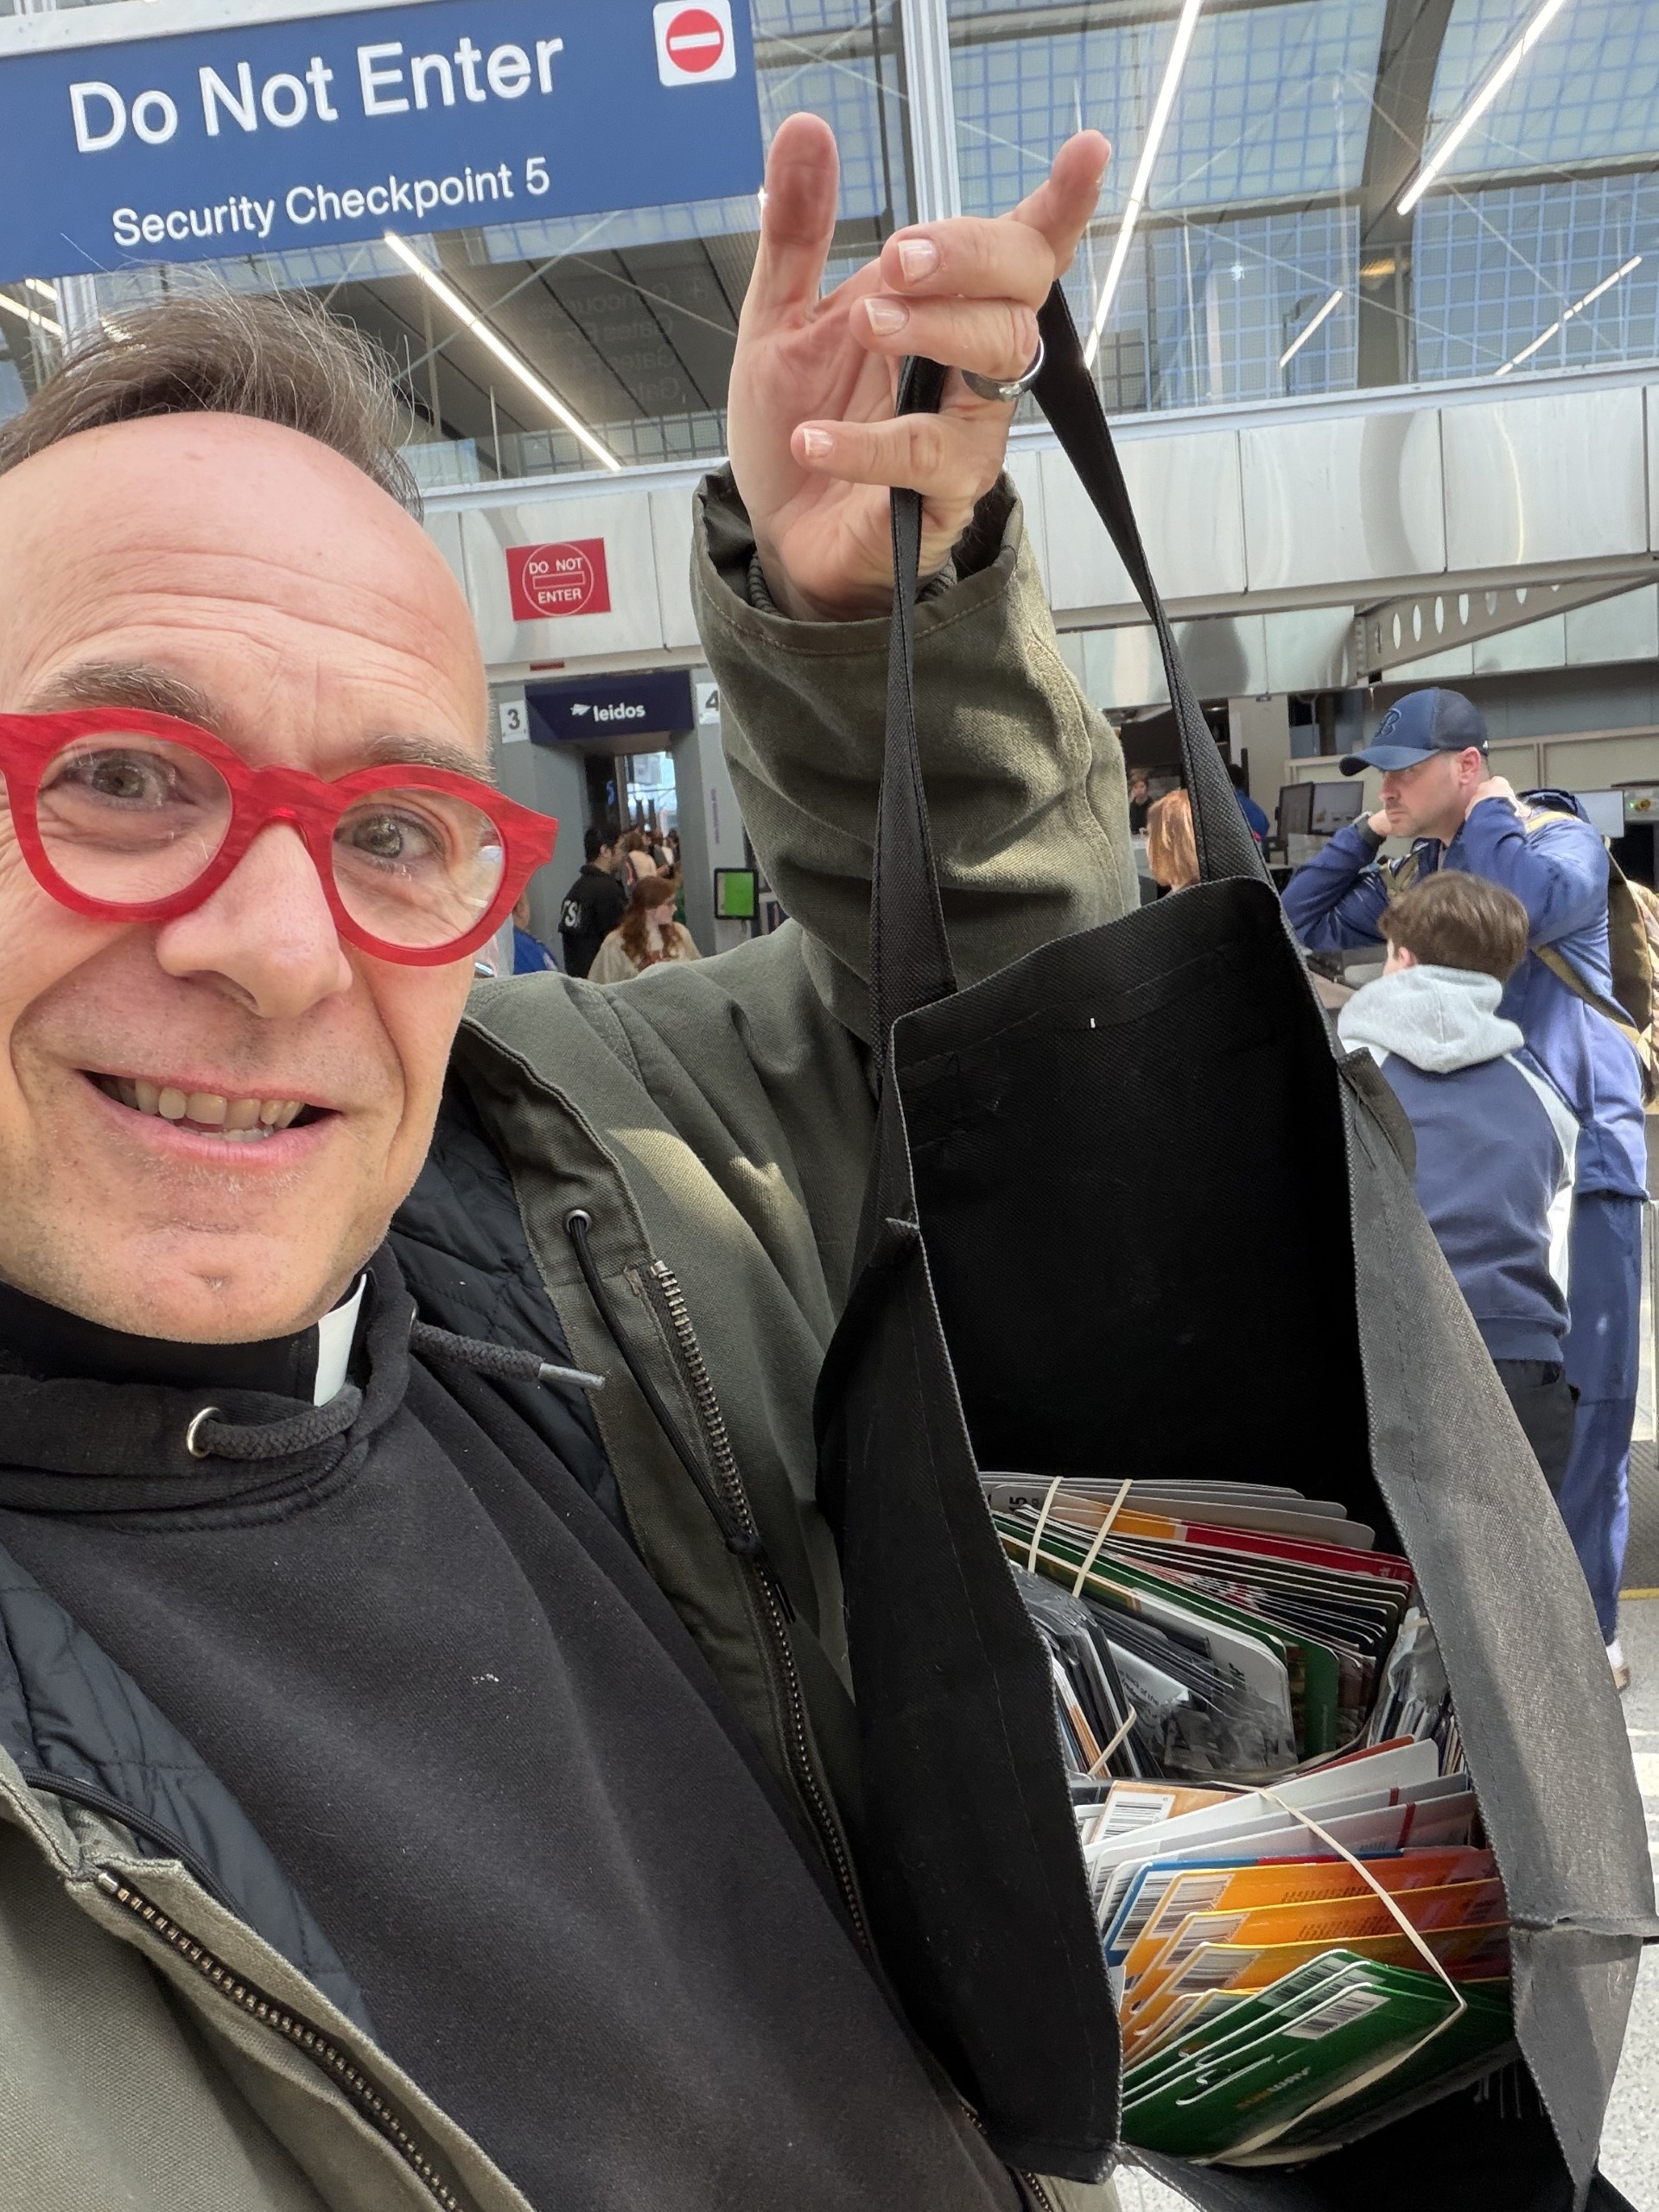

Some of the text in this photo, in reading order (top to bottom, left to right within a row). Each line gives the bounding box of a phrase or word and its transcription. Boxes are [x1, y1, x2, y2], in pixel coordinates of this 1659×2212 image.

[70, 36, 563, 152] Do Not Enter
[112, 156, 550, 246] Security Checkpoint 5
[529, 557, 582, 575] DO NOT
[537, 588, 582, 604] ENTER
[593, 702, 646, 722] leidos
[705, 690, 719, 712] 4
[507, 708, 520, 730] 3
